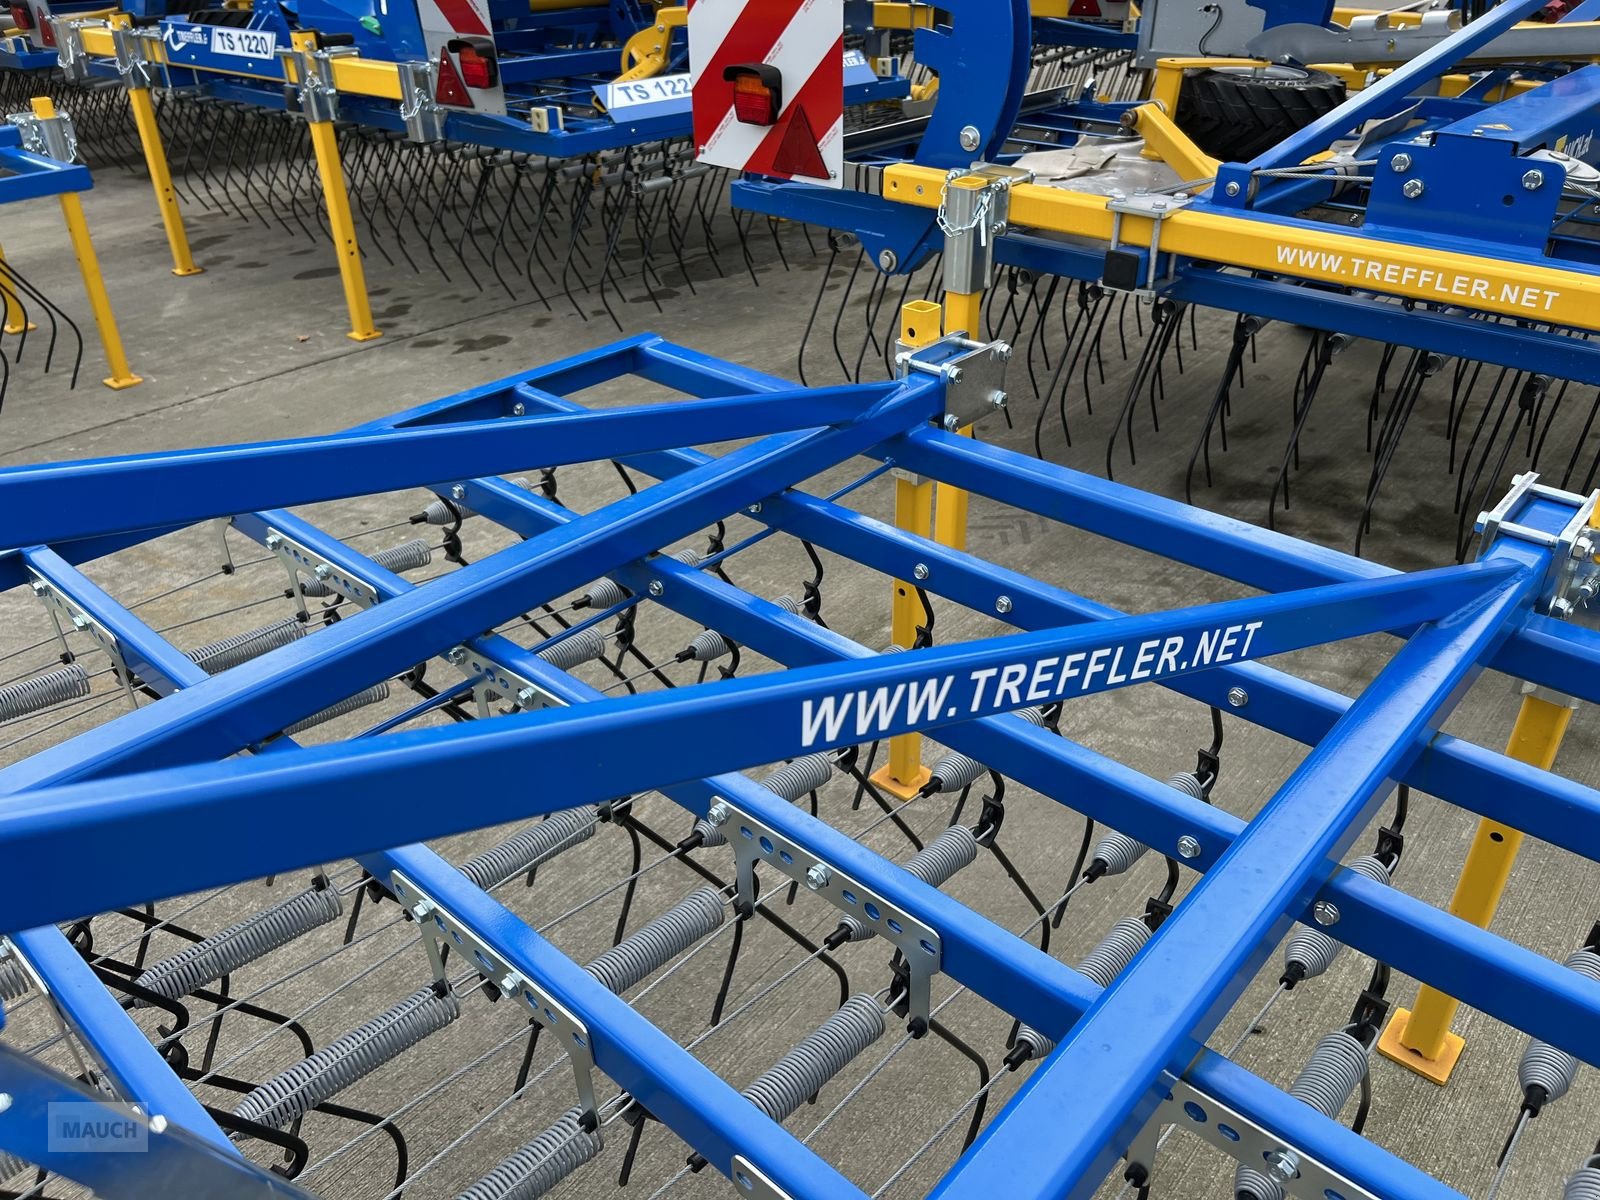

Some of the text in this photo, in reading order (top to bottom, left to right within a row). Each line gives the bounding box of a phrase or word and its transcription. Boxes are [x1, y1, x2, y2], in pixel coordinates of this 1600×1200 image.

[217, 32, 268, 55] TS 1220
[617, 77, 692, 102] TS 122
[1276, 245, 1560, 311] WWW.TREFFLER.NET
[801, 621, 1264, 748] WWW.TREFFLER.NET
